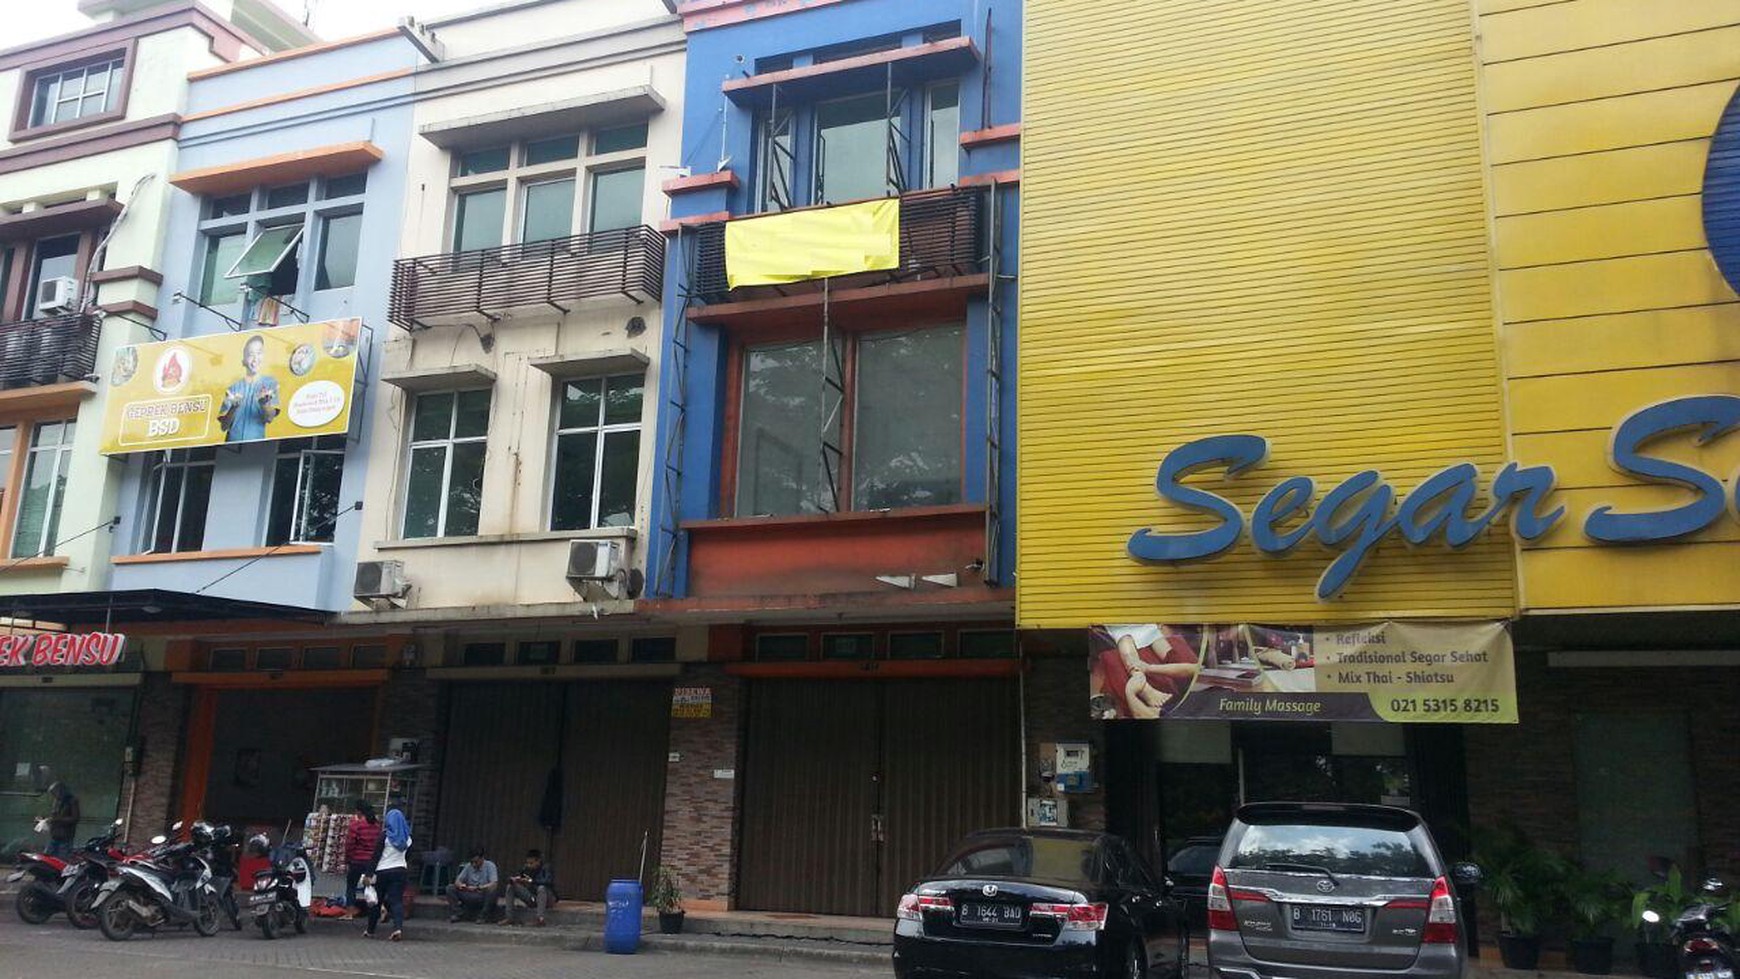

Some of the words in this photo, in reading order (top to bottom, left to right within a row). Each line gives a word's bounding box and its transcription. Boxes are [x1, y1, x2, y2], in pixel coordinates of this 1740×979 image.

[170, 399, 208, 414] BENSU
[149, 417, 180, 437] BSD
[1126, 433, 1567, 601] Segar
[1583, 394, 1740, 543] S
[1336, 631, 1386, 645] Refleksi
[31, 631, 125, 666] BENSU
[1338, 651, 1406, 664] Tradisional
[1410, 651, 1445, 666] Segar
[1450, 651, 1488, 664] Sehat
[1338, 671, 1362, 684] Mix
[1365, 671, 1393, 684] Thai
[1405, 671, 1455, 684] Shiatsu
[1219, 698, 1262, 715] Family
[1264, 699, 1321, 716] Massage
[1391, 699, 1417, 713] 021
[1422, 699, 1458, 713] 5315
[1463, 699, 1500, 713] 8215
[961, 903, 969, 915] B
[976, 905, 998, 918] 1644
[1293, 908, 1301, 920] B
[1312, 909, 1332, 921] 1761
